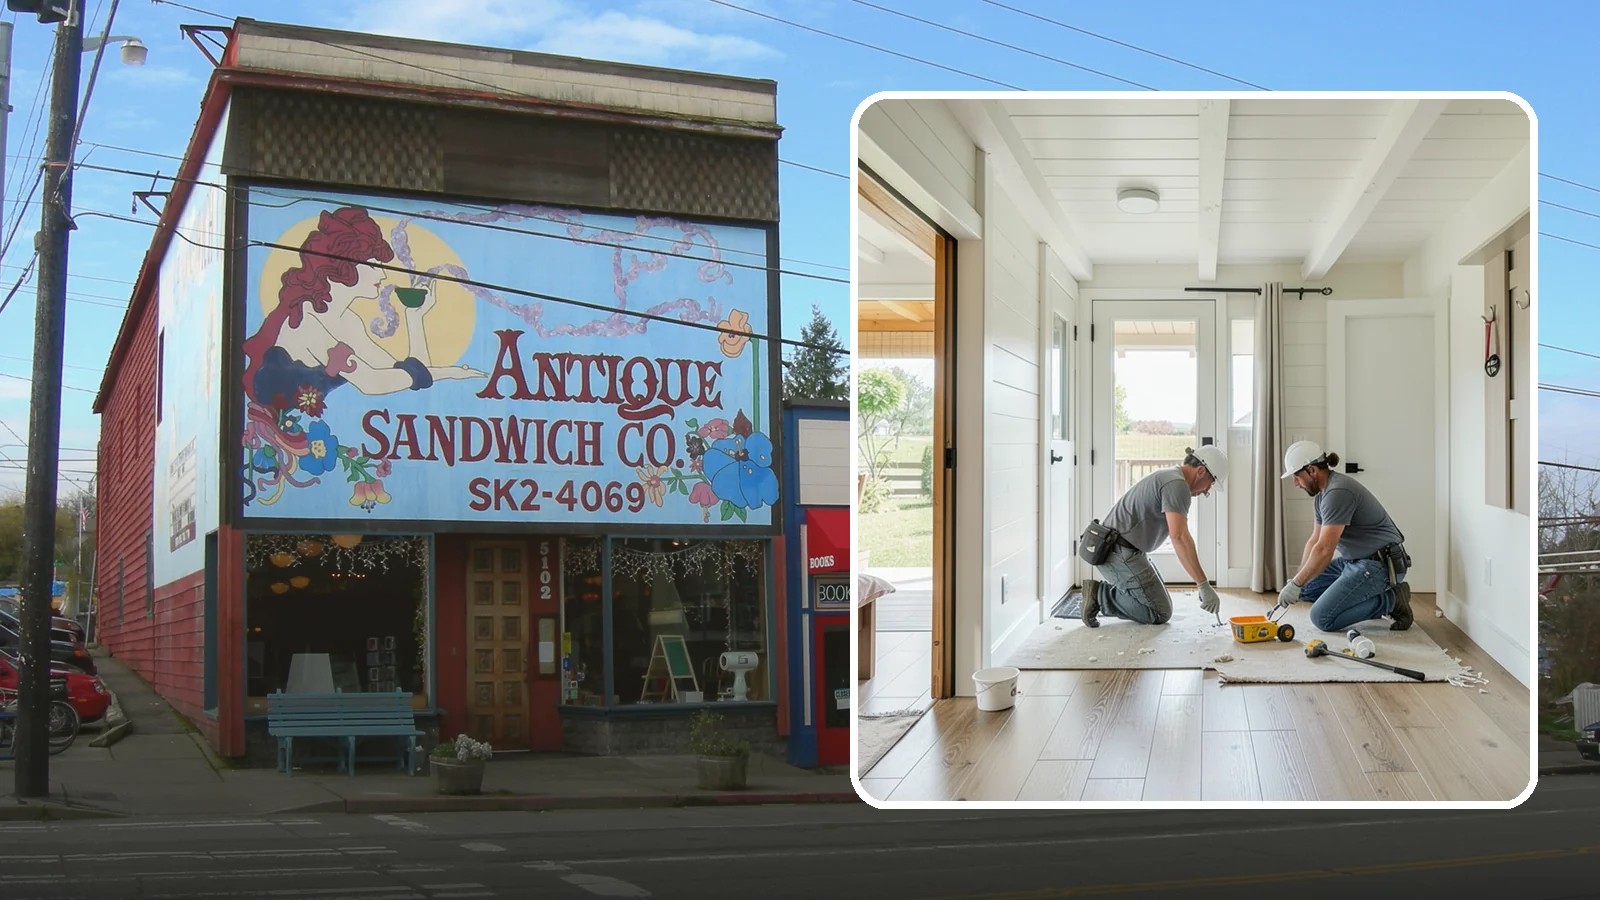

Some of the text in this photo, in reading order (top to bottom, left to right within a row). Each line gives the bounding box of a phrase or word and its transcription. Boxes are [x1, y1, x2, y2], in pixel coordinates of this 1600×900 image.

[475, 329, 724, 421] ANTIQUE
[361, 408, 685, 468] SANDWICH CO.
[468, 477, 646, 513] SK2-4069
[540, 541, 551, 600] 5102
[809, 555, 835, 569] BOOKS
